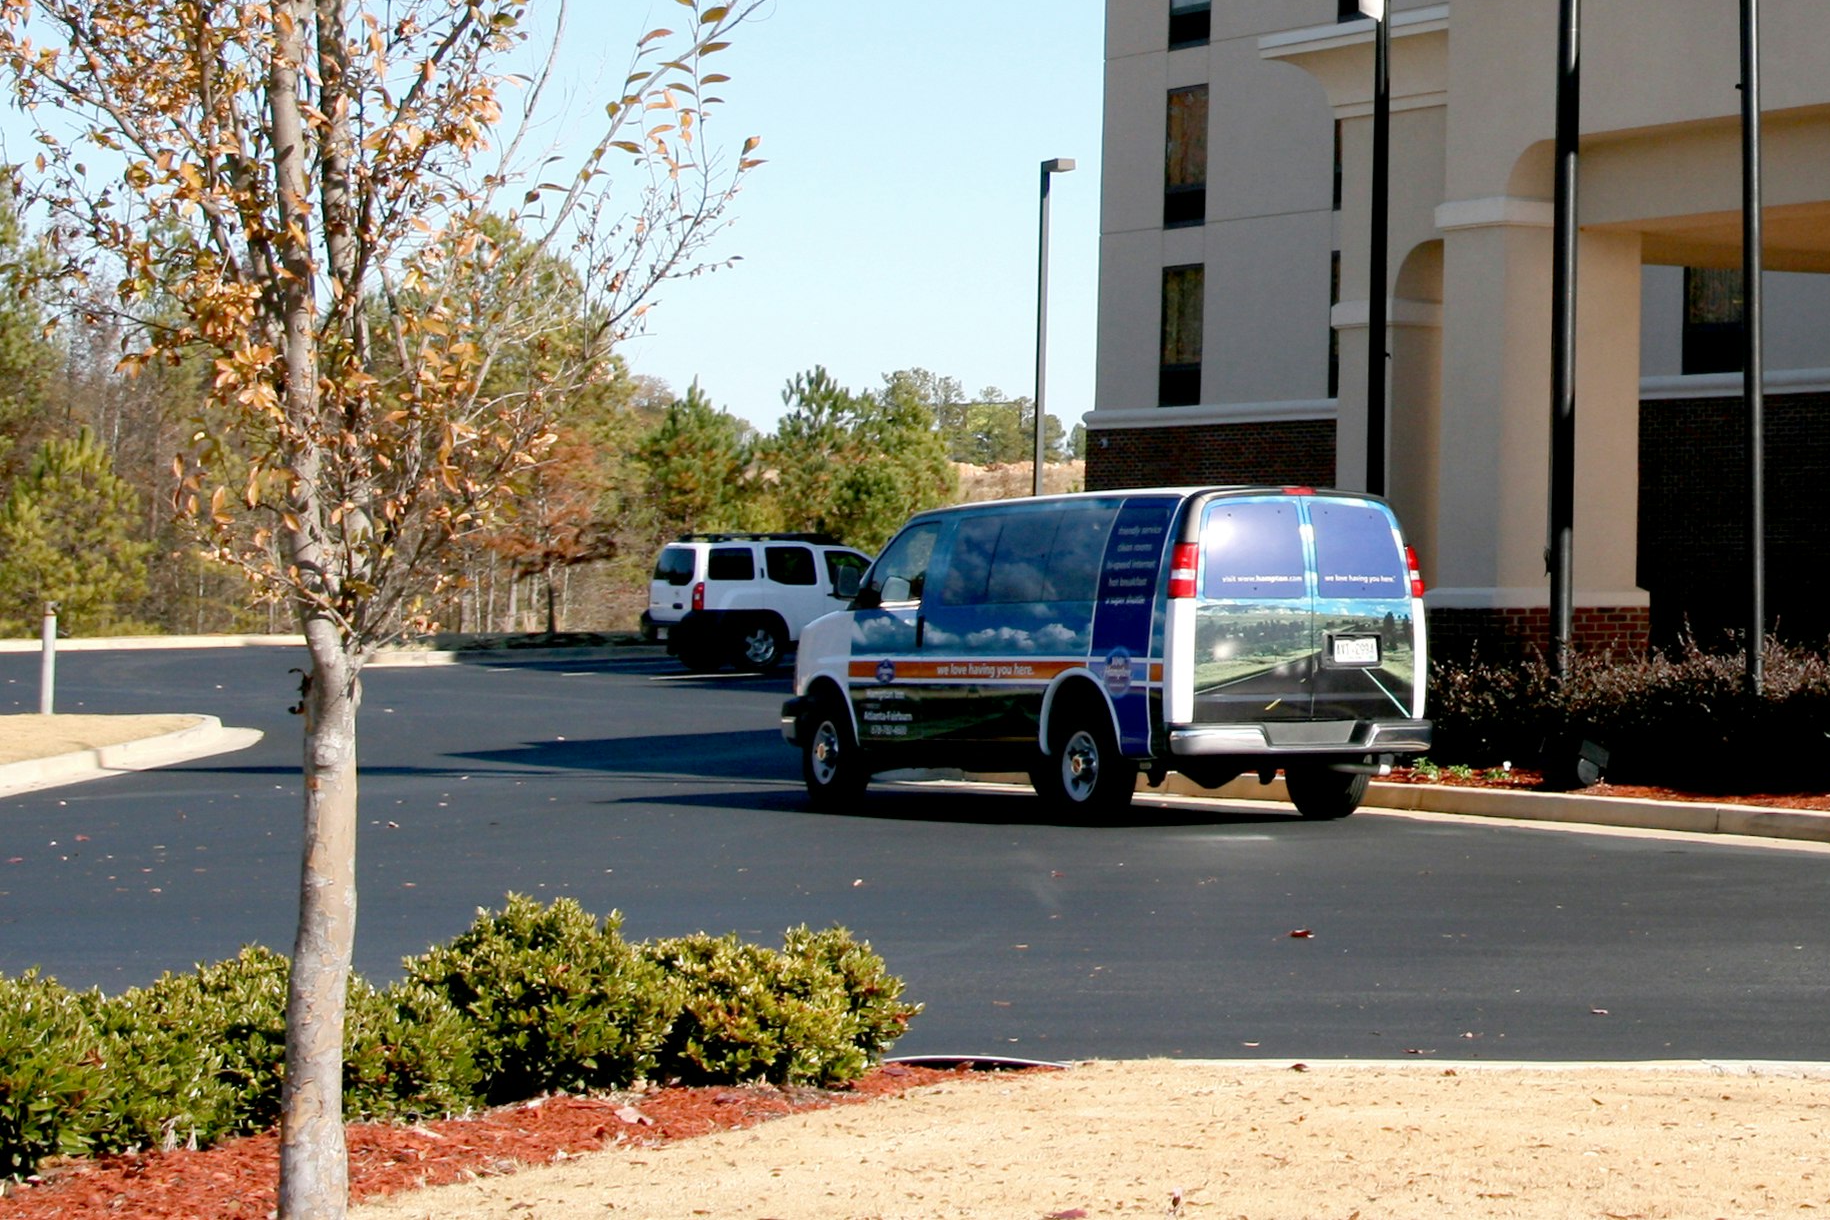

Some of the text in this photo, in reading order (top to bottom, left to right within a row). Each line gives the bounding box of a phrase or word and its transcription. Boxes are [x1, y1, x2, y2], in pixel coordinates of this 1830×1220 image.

[1222, 574, 1303, 584] visit www.hampton.com
[1335, 574, 1348, 582] love
[1348, 575, 1369, 584] having
[1369, 576, 1380, 584] you
[936, 663, 1035, 679] we love having you here.
